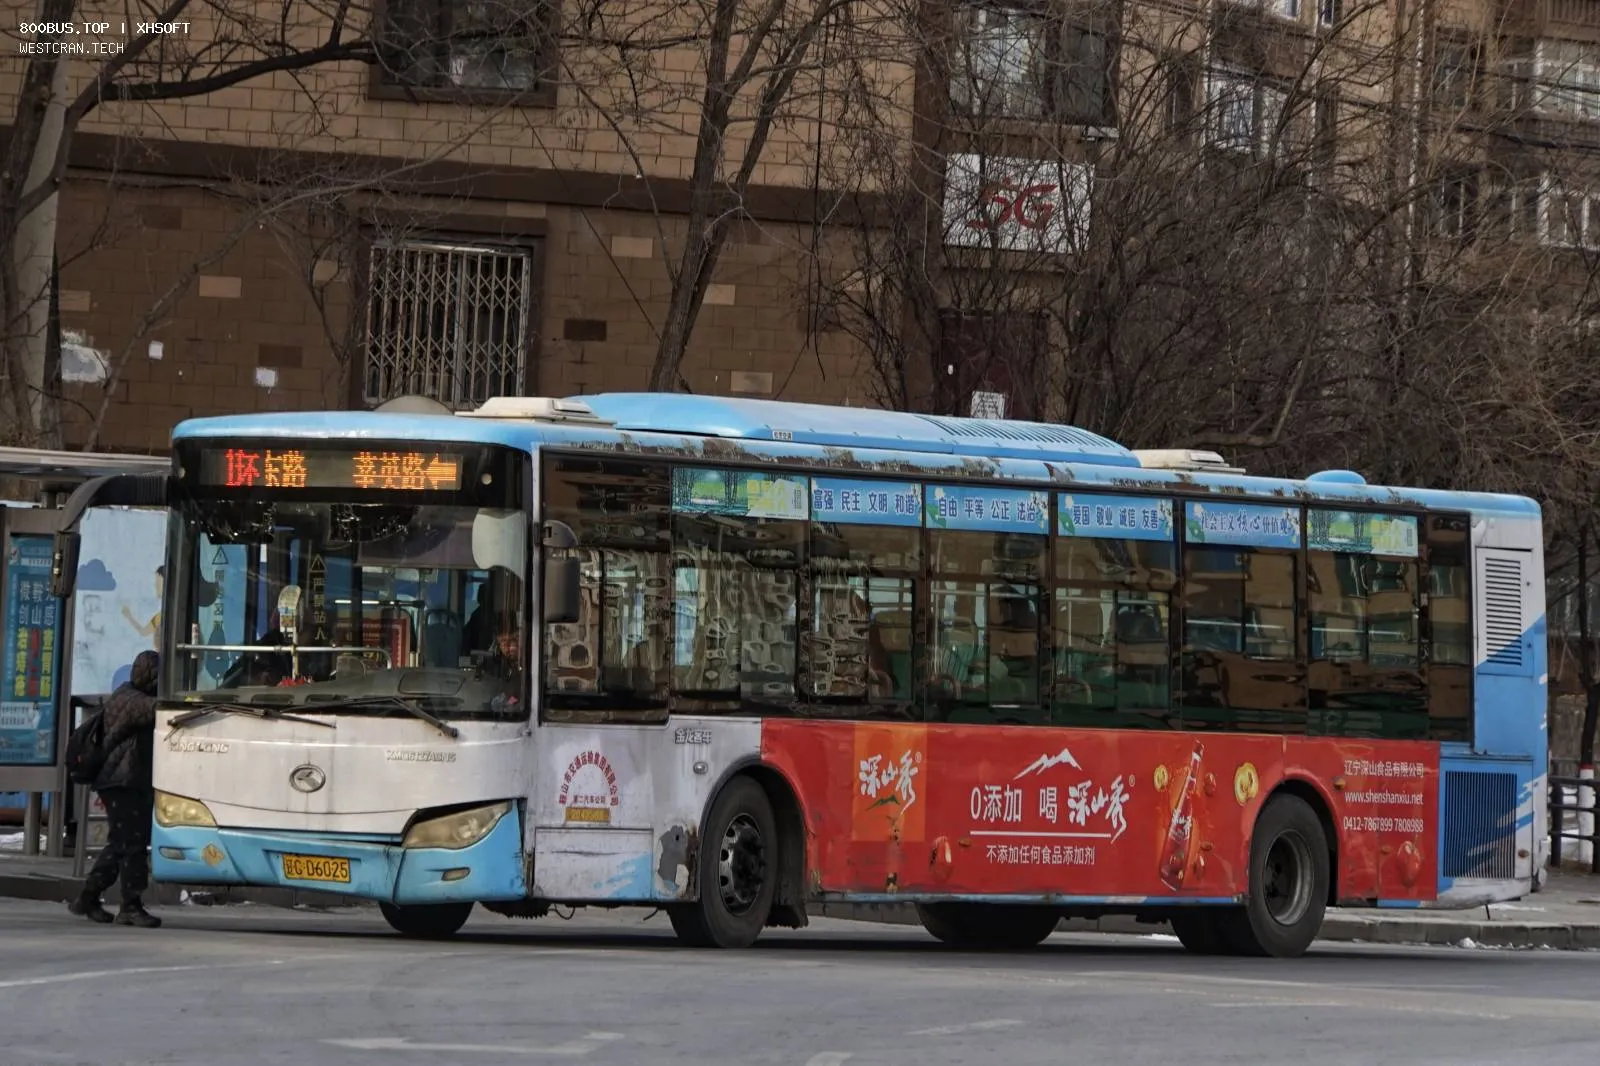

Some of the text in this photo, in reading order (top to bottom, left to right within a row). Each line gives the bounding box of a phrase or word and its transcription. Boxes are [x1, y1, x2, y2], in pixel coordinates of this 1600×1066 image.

[813, 489, 834, 510] 富强
[841, 491, 861, 512] 民主
[868, 492, 889, 512] 文明
[895, 494, 915, 514] 和谐
[939, 497, 1036, 522] 自由 平等 公正 法治
[1073, 505, 1158, 529] 爱国 敬业 诚信 友善
[675, 727, 712, 744] 金龙客车
[1344, 759, 1424, 778] 辽宁深山食品有限公司
[970, 784, 1022, 824] 0添加
[1039, 787, 1058, 824] 喝
[1344, 788, 1424, 805] www.shenshanxiu.net
[986, 845, 1096, 866] 不添加任何食品添加剂
